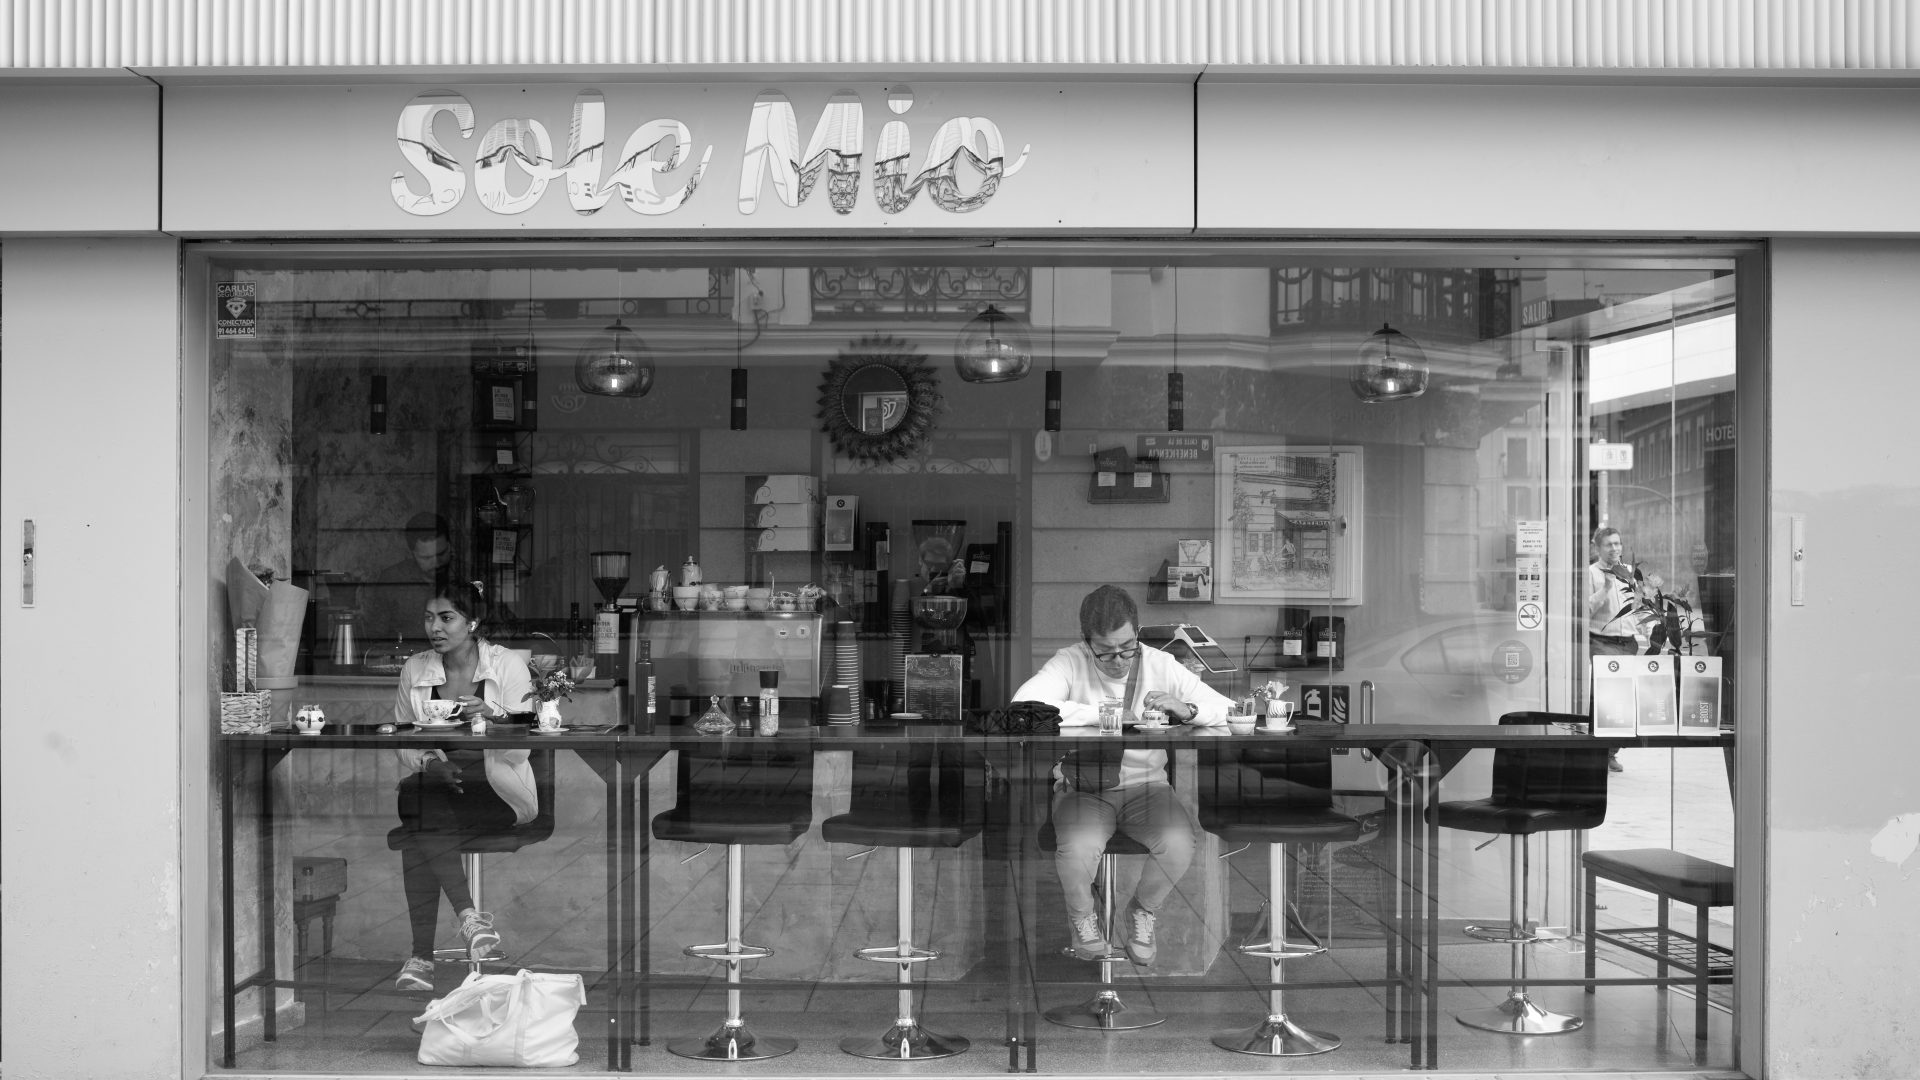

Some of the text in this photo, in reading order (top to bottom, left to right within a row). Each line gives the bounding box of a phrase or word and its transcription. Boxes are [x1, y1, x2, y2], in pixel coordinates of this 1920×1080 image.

[390, 84, 1031, 216] Sole Mio
[1522, 299, 1553, 325] SALIDA
[1706, 424, 1736, 443] HOTEL
